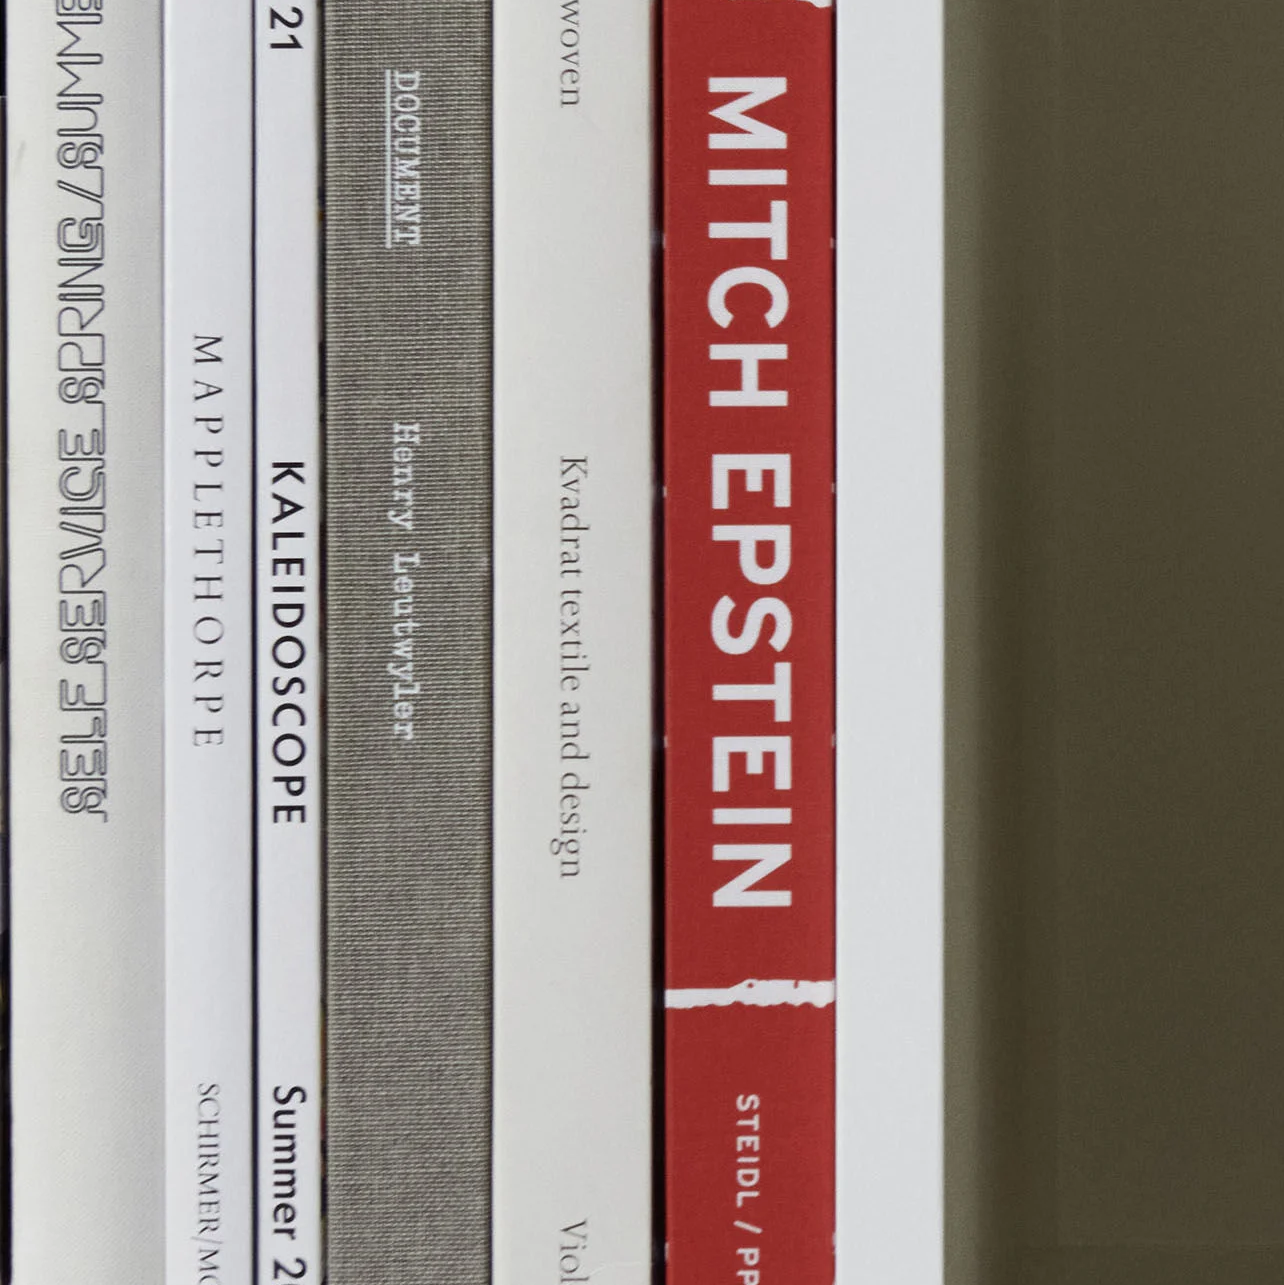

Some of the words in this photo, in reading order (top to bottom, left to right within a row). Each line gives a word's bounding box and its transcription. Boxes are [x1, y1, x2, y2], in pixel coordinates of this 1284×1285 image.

[270, 6, 304, 49] 21
[396, 72, 425, 247] DOCUMENT
[707, 76, 789, 407] MITCH
[57, 429, 106, 665] SERVICE
[194, 335, 223, 744] MAPPLETHORPE
[388, 420, 420, 530] Henry
[561, 458, 590, 574] Kvadrat
[271, 461, 306, 823] KALEIDOSCOPE
[388, 552, 420, 741] Leutwyler
[561, 590, 590, 691] textile
[711, 453, 793, 908] EPSTEIN
[561, 702, 590, 760] and
[550, 772, 590, 877] design
[273, 1086, 307, 1240] Summer
[735, 1094, 760, 1208] STEIDL
